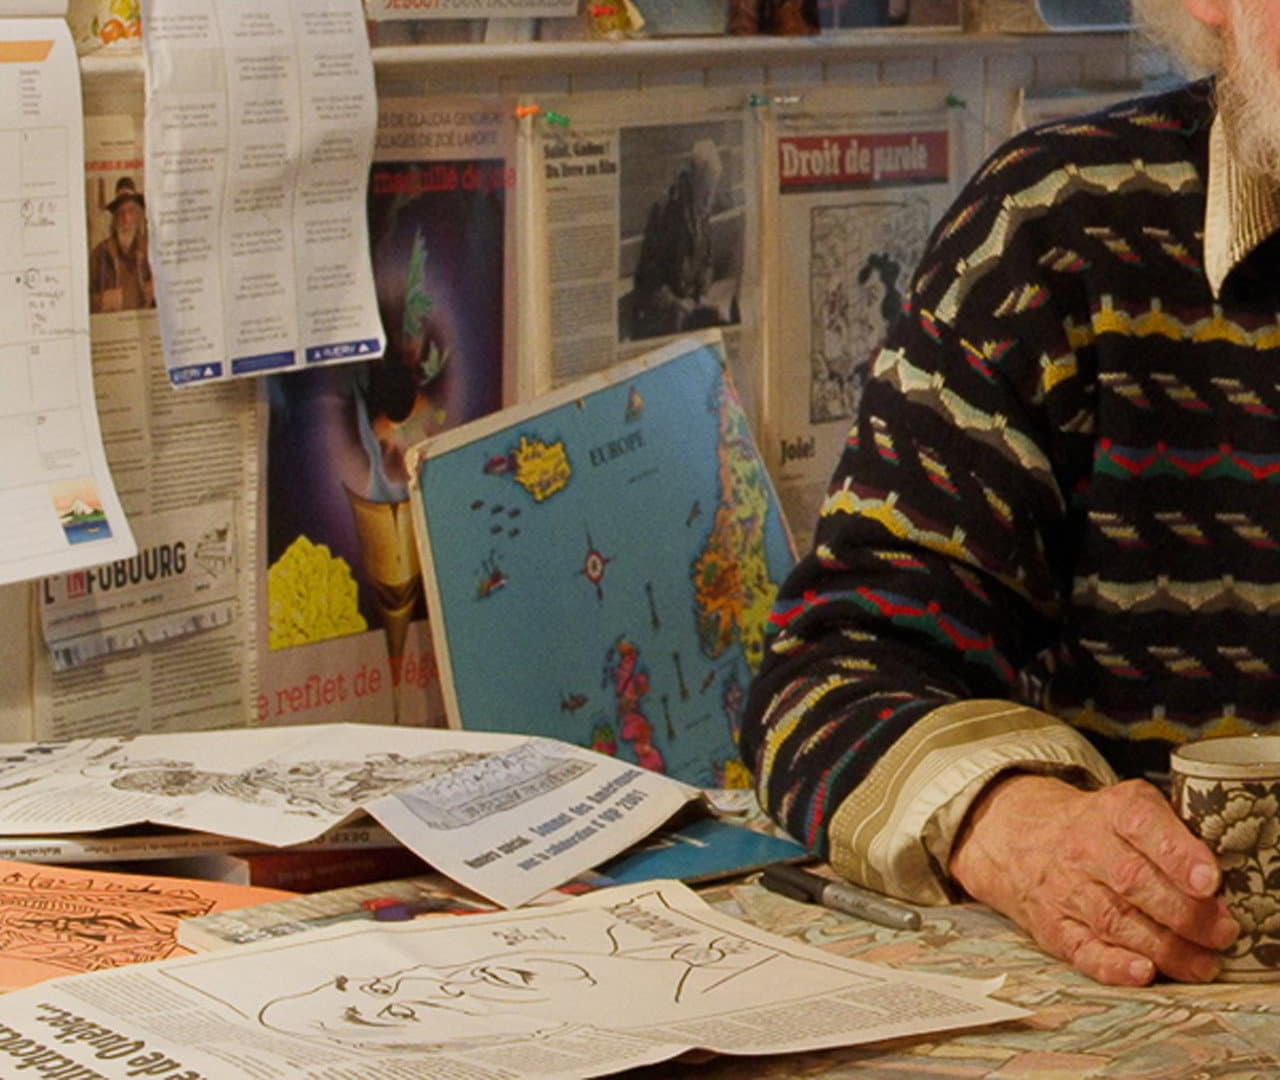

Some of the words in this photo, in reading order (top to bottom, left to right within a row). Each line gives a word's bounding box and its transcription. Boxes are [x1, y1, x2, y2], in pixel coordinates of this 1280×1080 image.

[781, 138, 841, 178] Droit
[844, 138, 871, 175] de
[873, 136, 928, 181] parole
[589, 429, 645, 467] EUROPE
[275, 673, 347, 716] reflet
[353, 663, 382, 698] de
[126, 1051, 182, 1077] de
